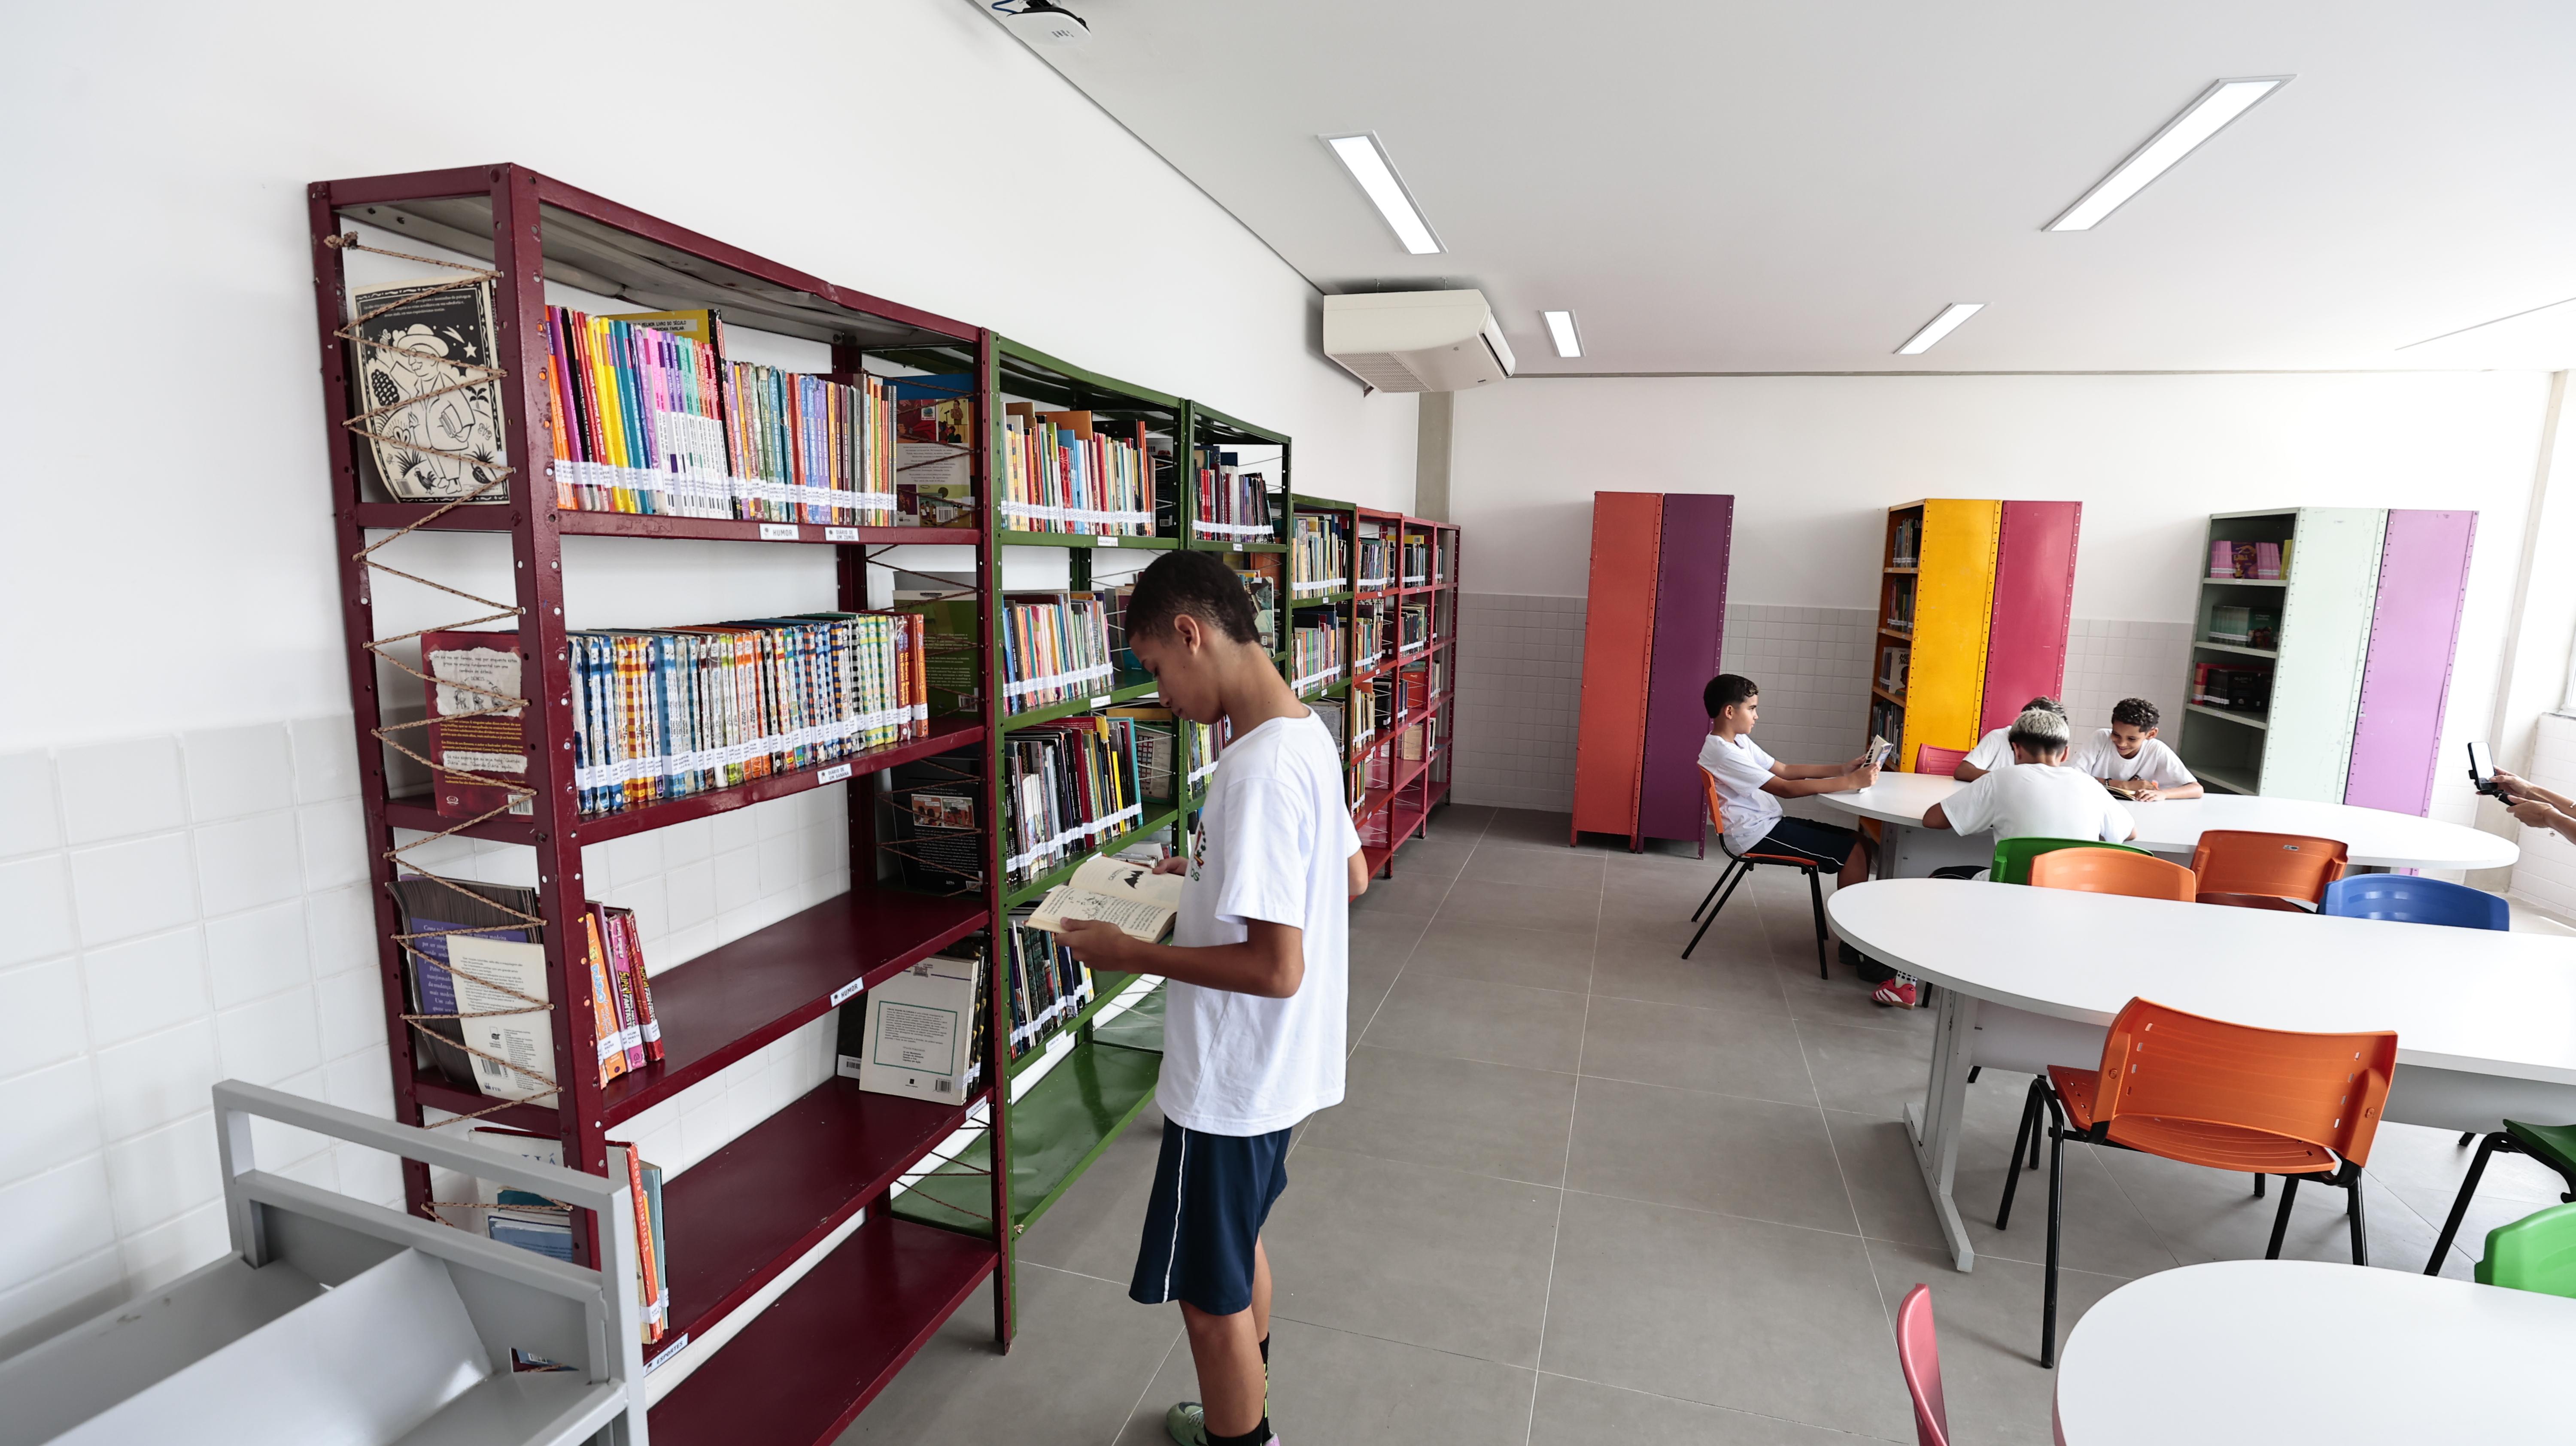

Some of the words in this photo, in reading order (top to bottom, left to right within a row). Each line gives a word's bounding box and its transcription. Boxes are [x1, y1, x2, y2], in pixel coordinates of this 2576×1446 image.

[617, 970, 632, 995] SUPER!
[638, 965, 649, 988] SUPER!
[841, 984, 858, 998] HUMOR
[633, 1157, 641, 1191] JOGOS
[656, 1341, 683, 1364] ESPORTES
